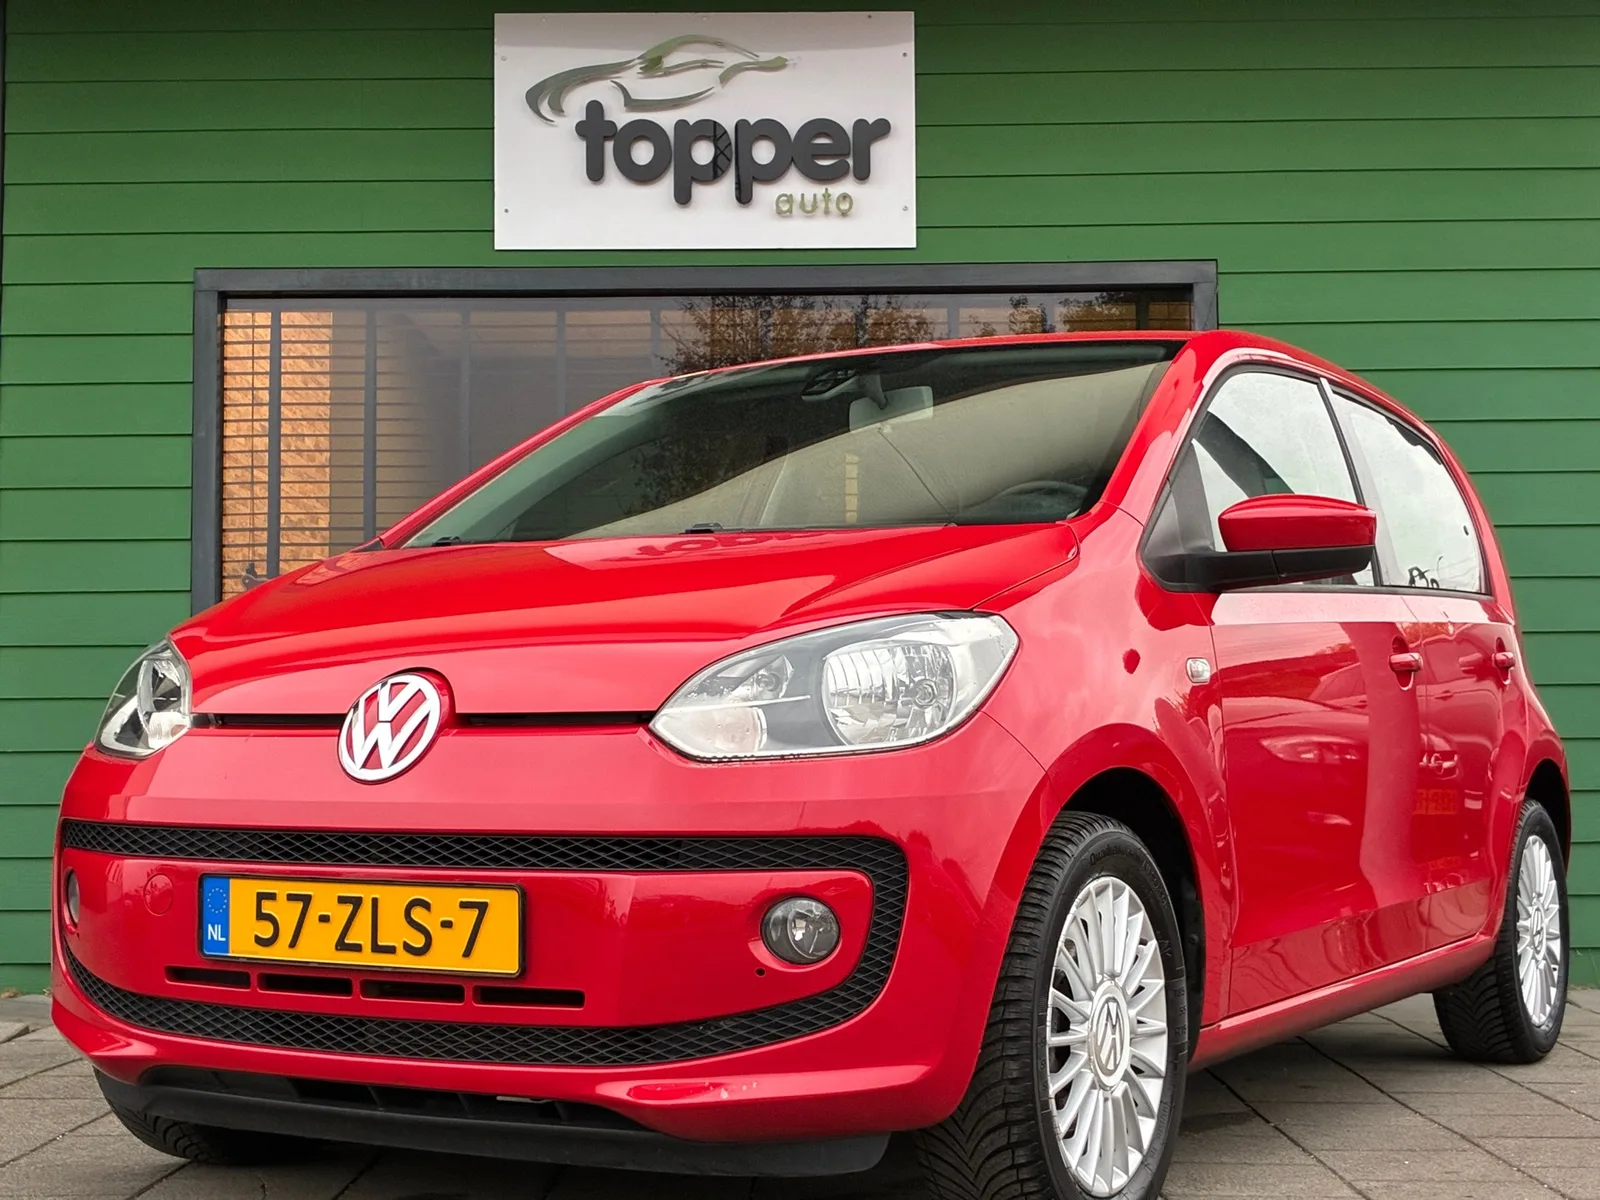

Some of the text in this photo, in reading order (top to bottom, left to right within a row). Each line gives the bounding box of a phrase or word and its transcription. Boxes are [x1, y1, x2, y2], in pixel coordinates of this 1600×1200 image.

[575, 99, 892, 206] topper
[774, 187, 855, 217] auto
[339, 672, 441, 781] VW
[207, 923, 227, 942] NL
[253, 890, 490, 959] 57-ZLS-7
